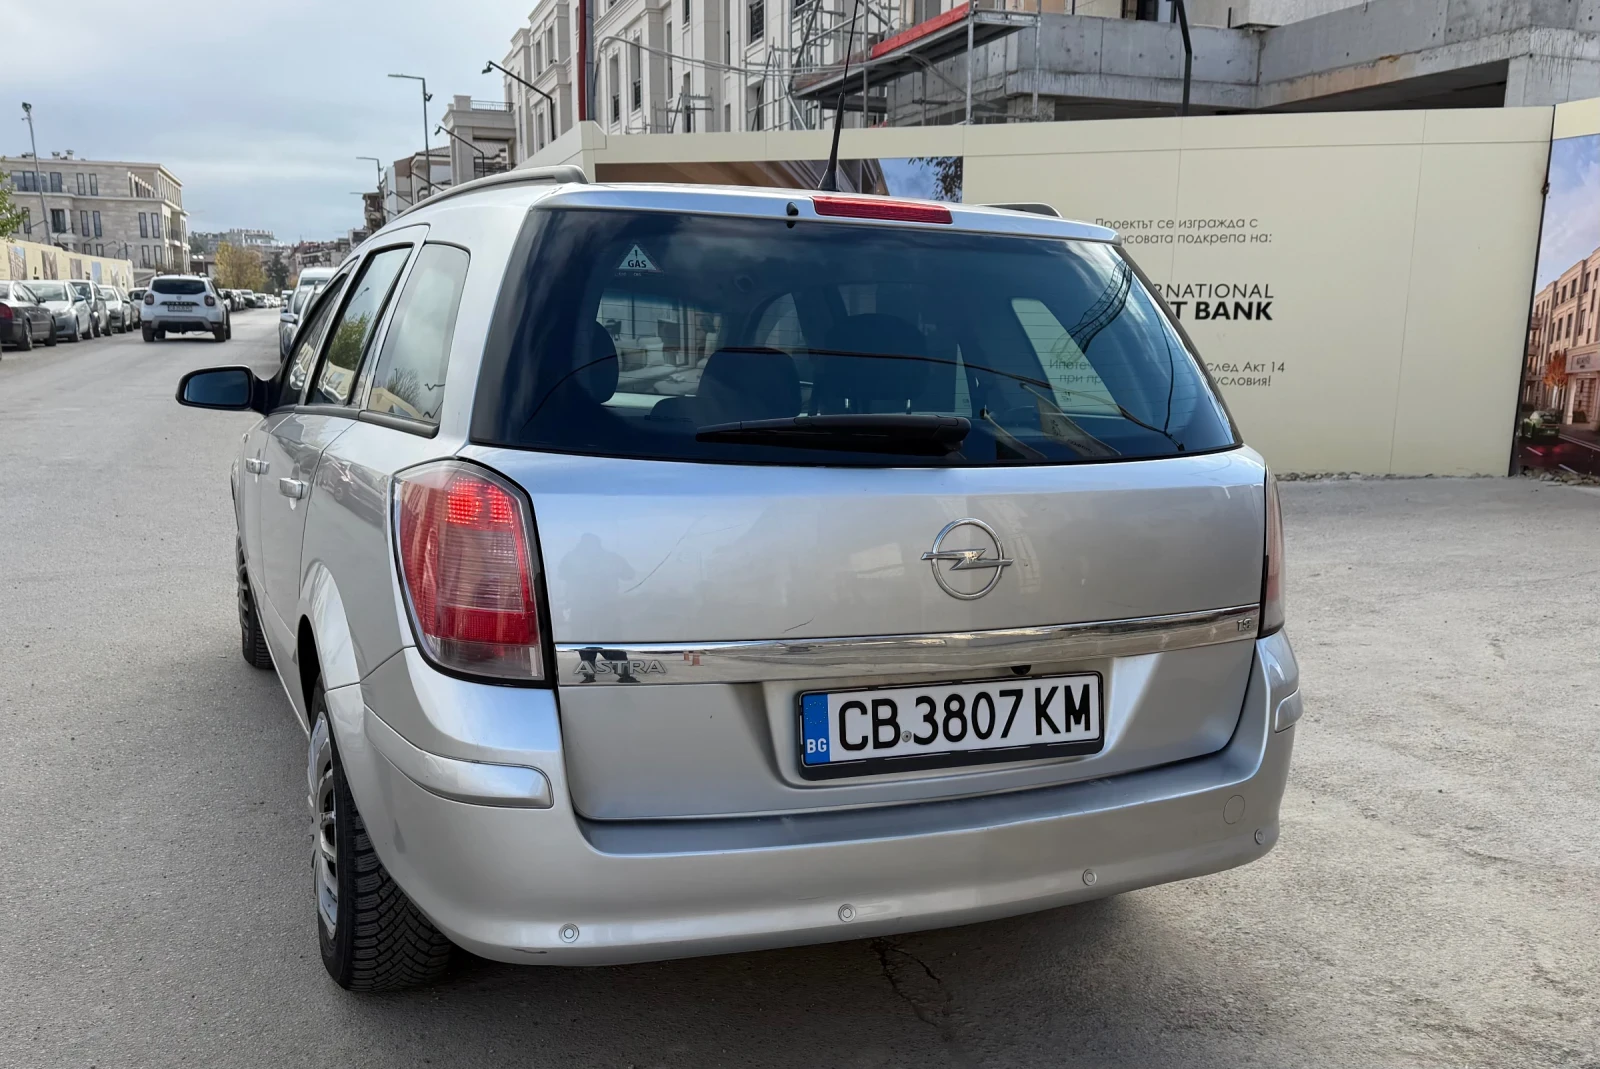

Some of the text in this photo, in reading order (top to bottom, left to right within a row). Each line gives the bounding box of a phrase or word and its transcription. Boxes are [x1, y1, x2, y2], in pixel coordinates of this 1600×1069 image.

[1157, 219, 1175, 229] се
[1178, 218, 1245, 231] изгражда
[1249, 218, 1259, 228] с
[1177, 233, 1246, 246] подкрепа
[1250, 233, 1272, 243] на:
[627, 259, 647, 268] GAS
[1194, 301, 1273, 321] BANK
[1242, 361, 1266, 372] Акт
[1271, 361, 1285, 372] 14
[574, 659, 666, 675] ASTRA
[838, 684, 1091, 751] CB 3807 KM
[806, 738, 827, 753] BG
